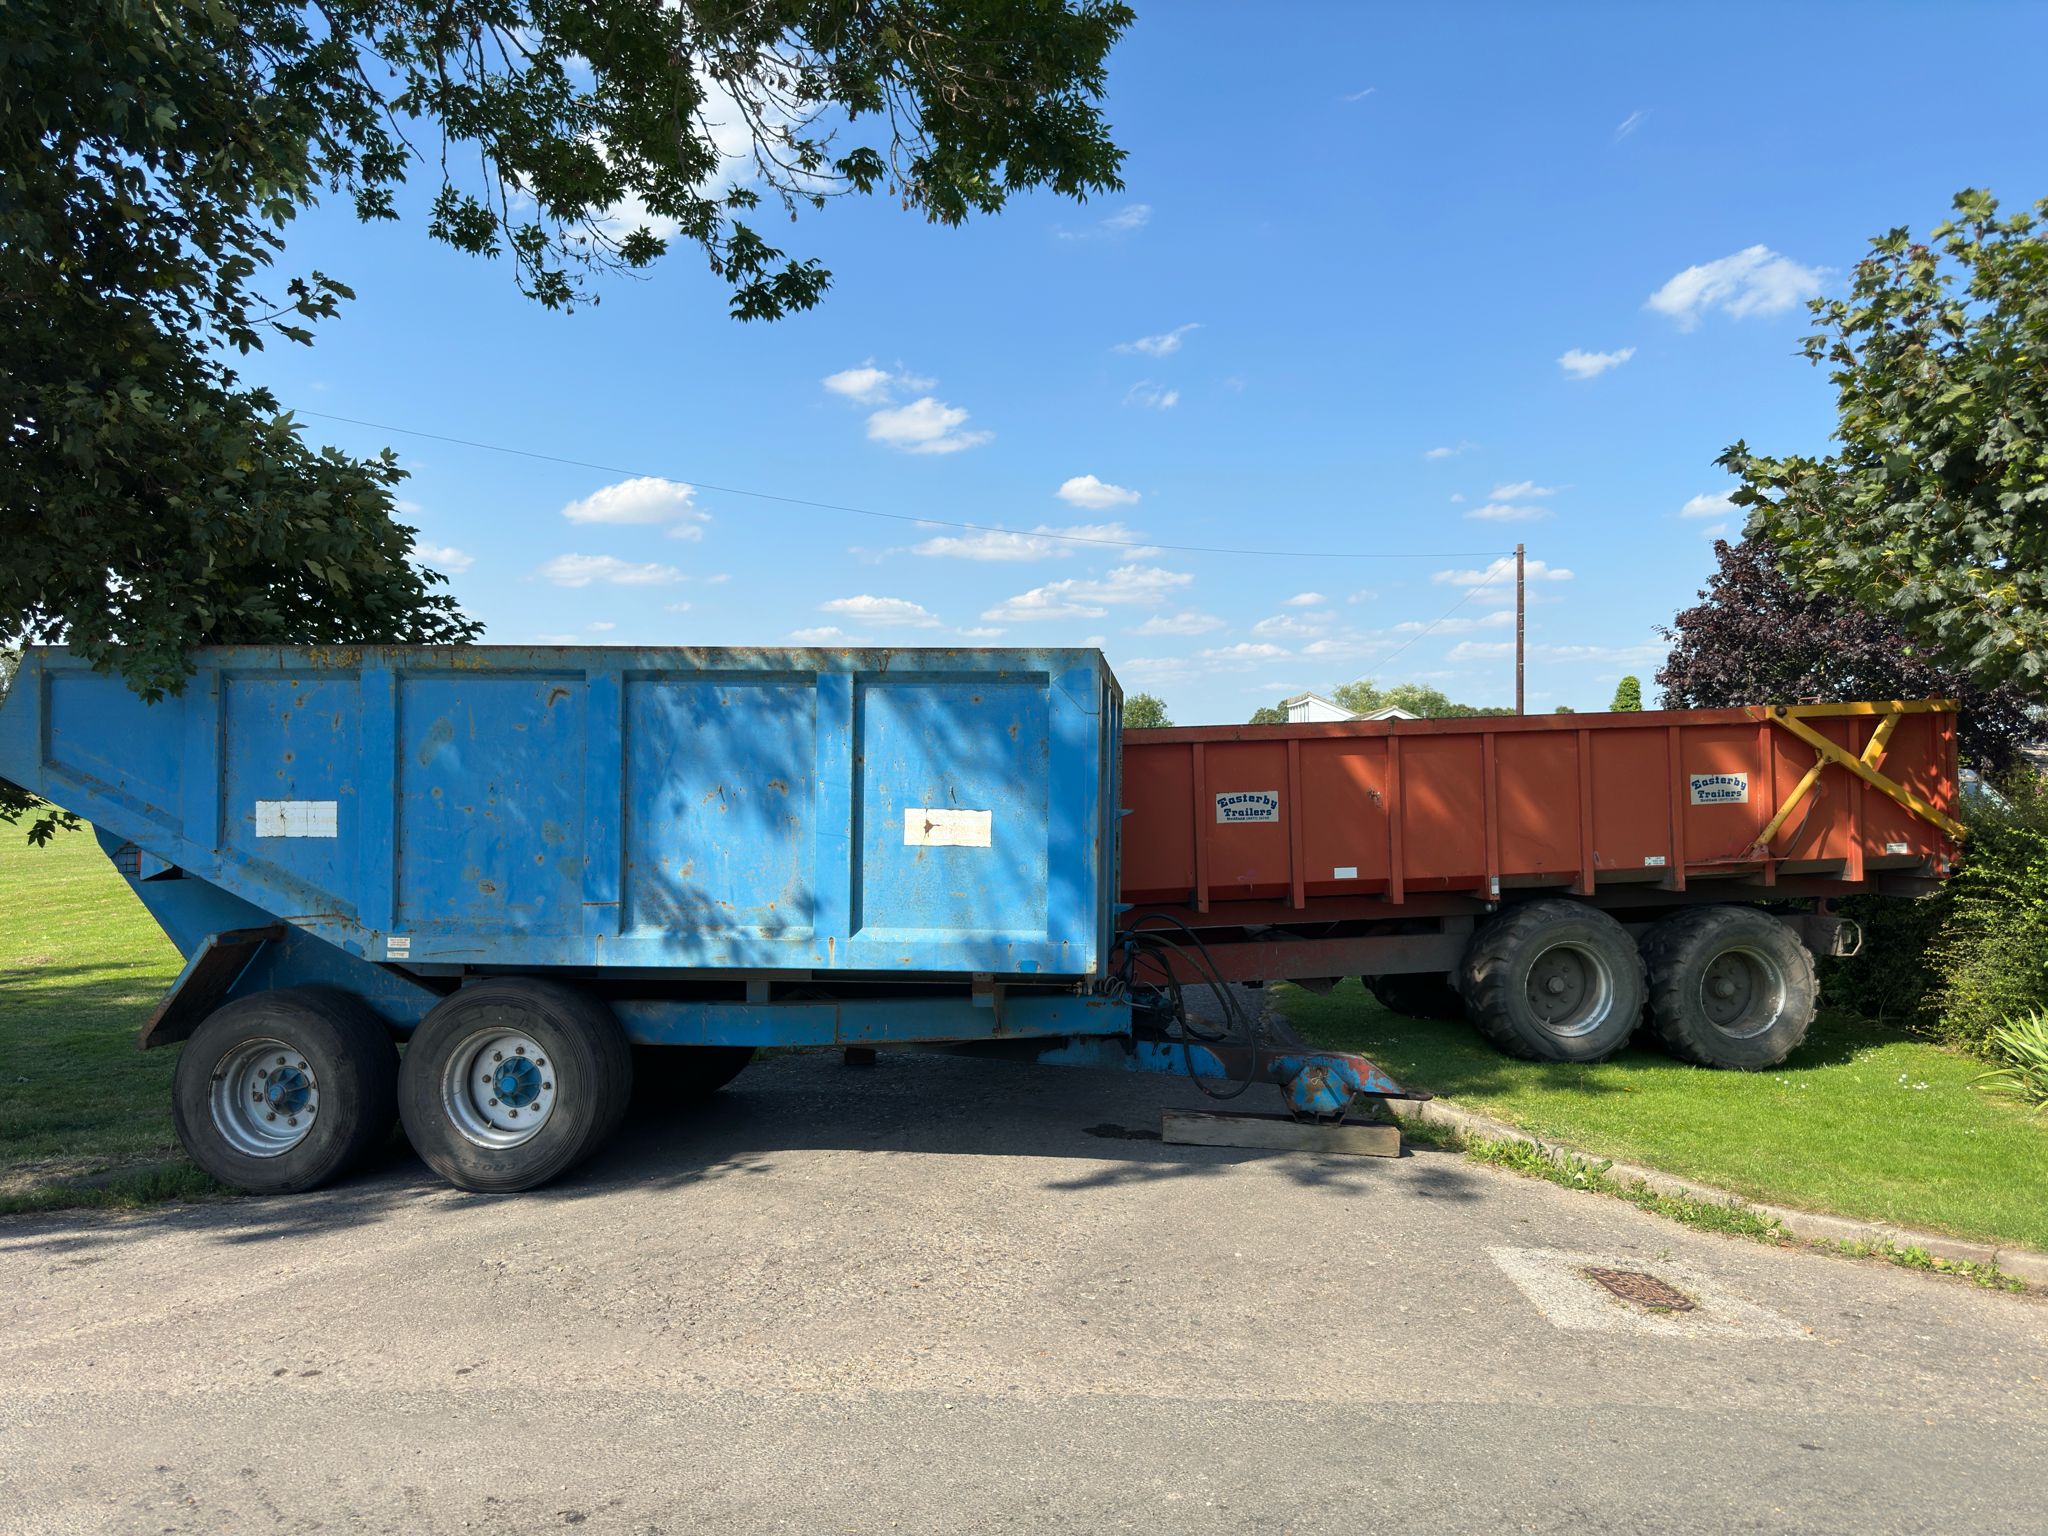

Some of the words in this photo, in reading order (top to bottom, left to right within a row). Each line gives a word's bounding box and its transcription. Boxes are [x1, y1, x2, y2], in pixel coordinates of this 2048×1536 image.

[1691, 776, 1746, 790] Easterby
[1697, 789, 1742, 798] Trailers
[1217, 794, 1277, 809] Easterby
[1224, 808, 1272, 817] Trailers
